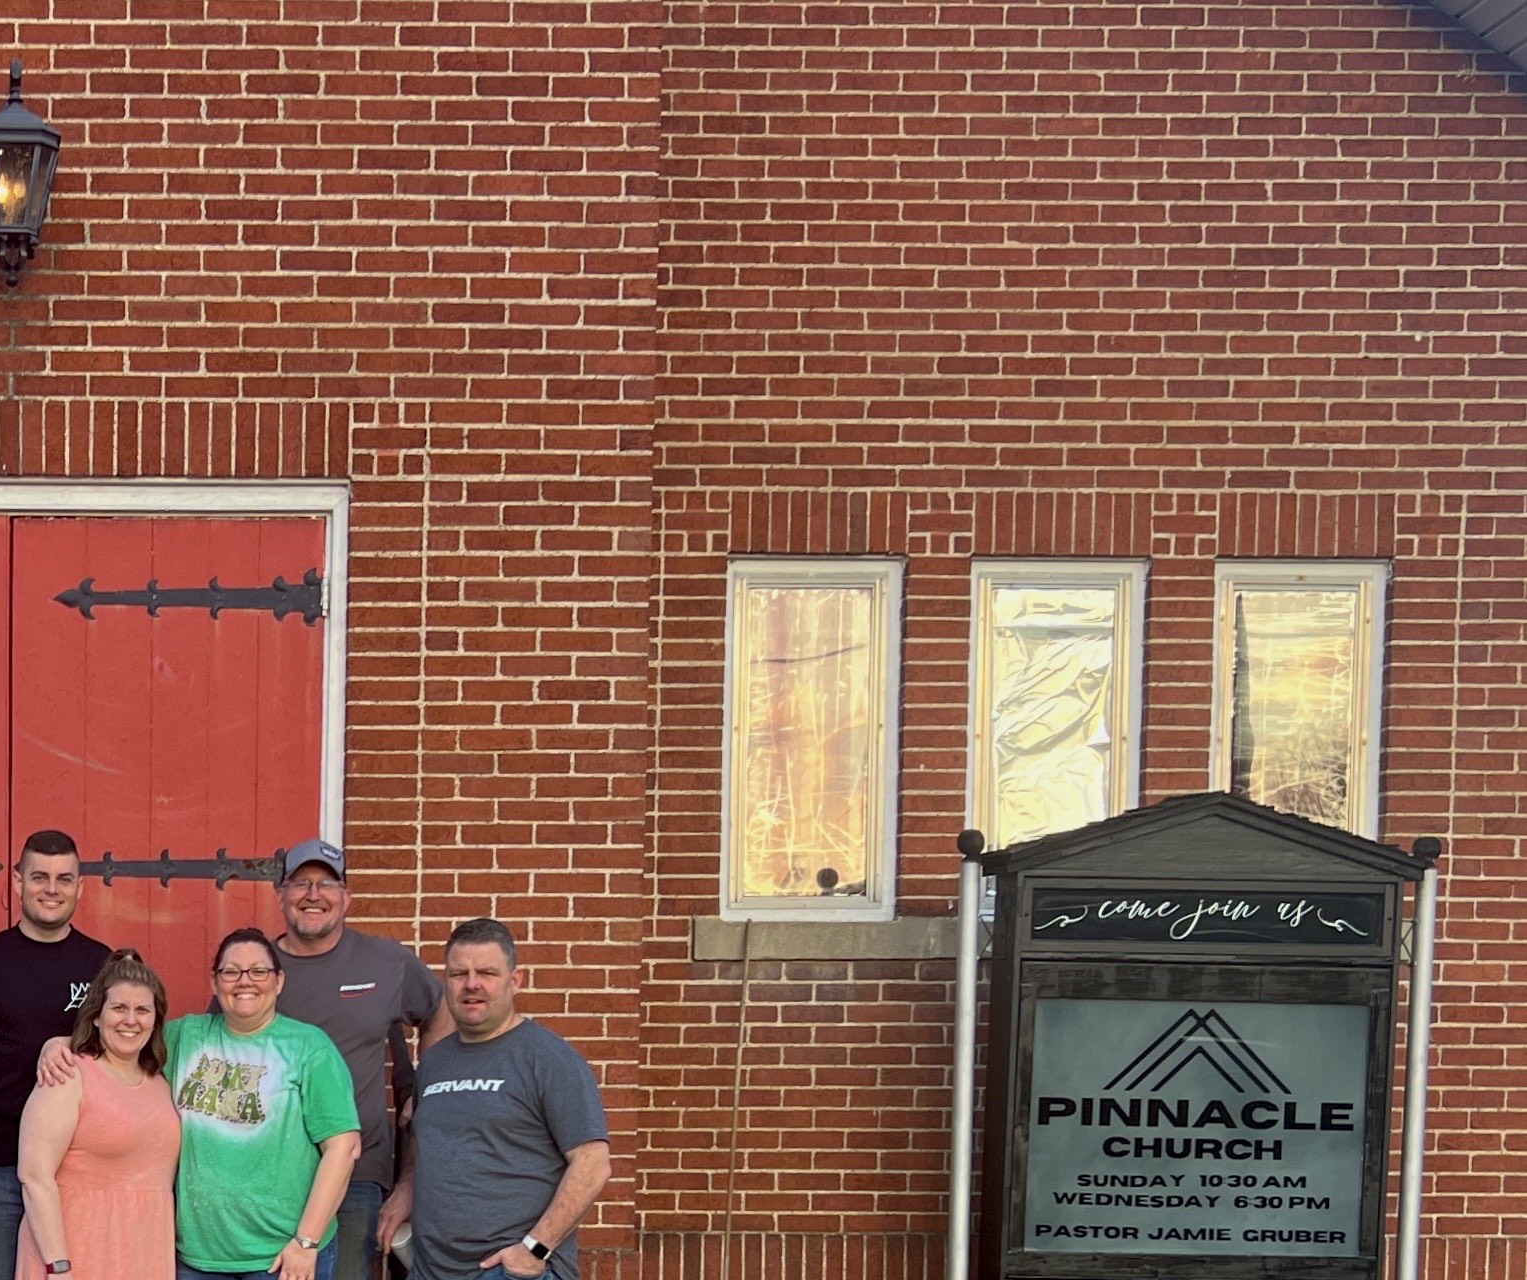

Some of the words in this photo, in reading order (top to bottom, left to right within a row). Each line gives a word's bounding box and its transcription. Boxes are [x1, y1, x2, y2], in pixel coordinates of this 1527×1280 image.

[1097, 899, 1180, 920] come
[1169, 898, 1260, 940] join
[1276, 899, 1314, 928] us
[422, 1079, 505, 1098] SERVANT
[1036, 1096, 1355, 1132] PINNACLE
[1102, 1136, 1283, 1161] CHURCH
[1076, 1173, 1186, 1188] SUNDAY
[1261, 1175, 1307, 1188] AM
[1052, 1191, 1221, 1208] WEDNESDAY
[1288, 1196, 1330, 1210] PM
[1034, 1224, 1139, 1240] PASTOR
[1147, 1227, 1232, 1242] JAMIE
[1242, 1229, 1347, 1244] GRUBER
